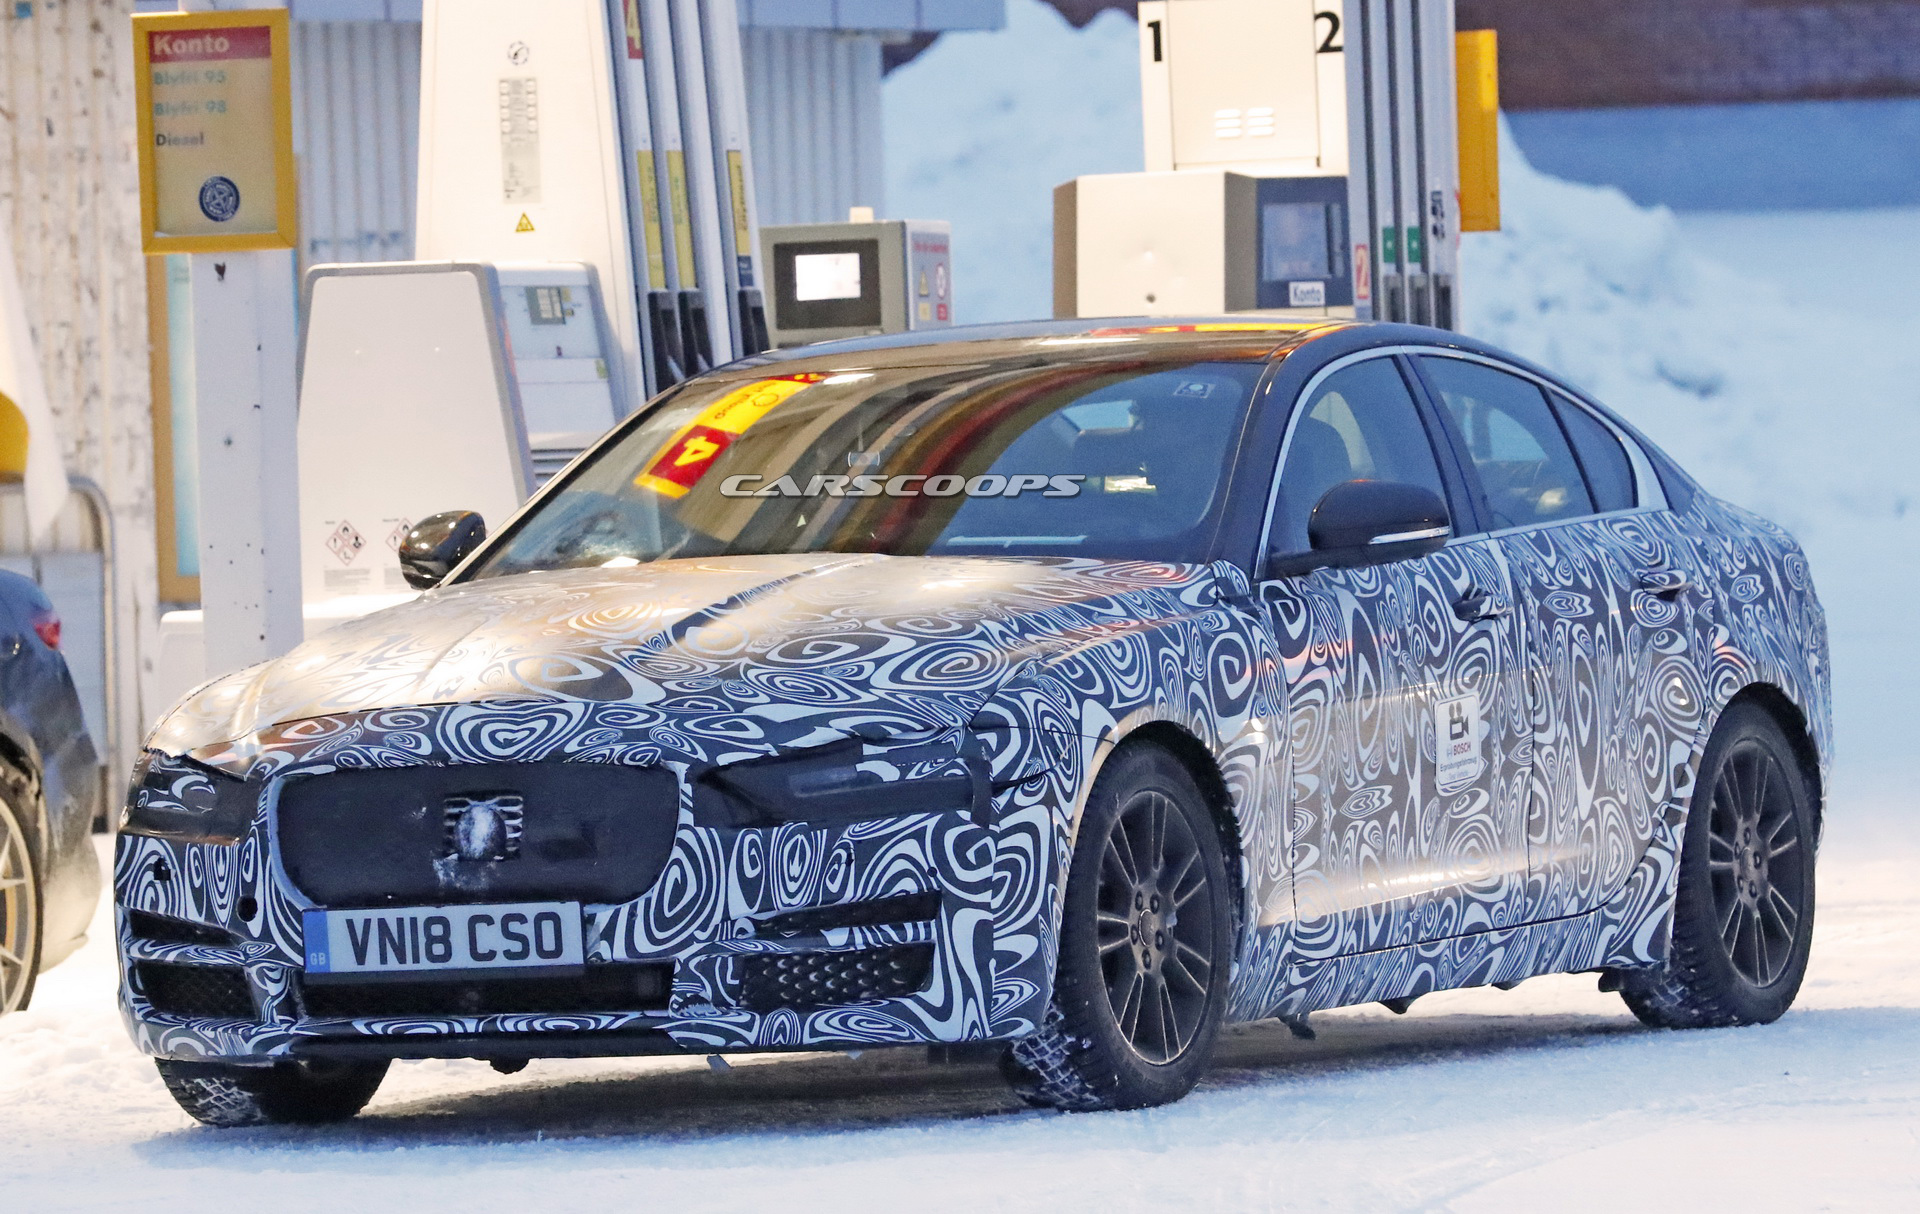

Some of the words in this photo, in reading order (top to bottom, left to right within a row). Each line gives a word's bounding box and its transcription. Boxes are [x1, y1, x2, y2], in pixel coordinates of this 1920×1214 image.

[1147, 20, 1162, 62] 1
[1314, 11, 1344, 54] 2
[153, 34, 230, 56] Konto
[156, 131, 204, 146] Diesel
[1453, 741, 1472, 757] BOSCH
[345, 916, 453, 966] VN18
[467, 911, 563, 962] CSO
[309, 952, 327, 967] GB
